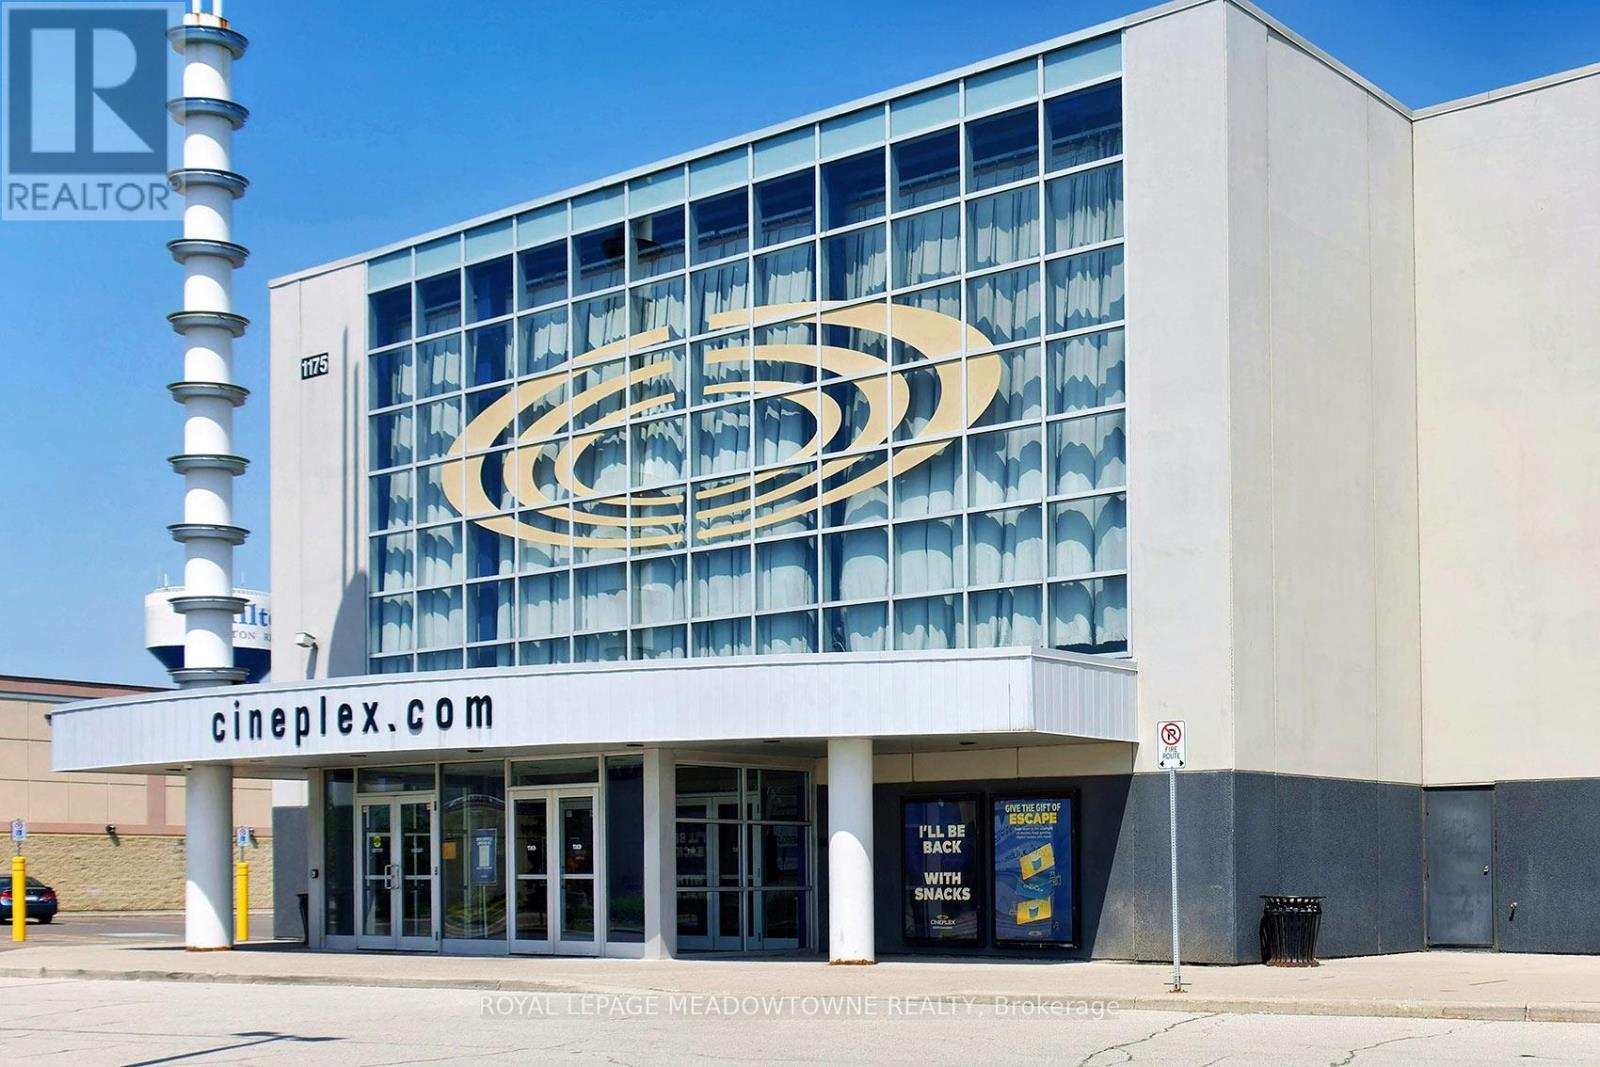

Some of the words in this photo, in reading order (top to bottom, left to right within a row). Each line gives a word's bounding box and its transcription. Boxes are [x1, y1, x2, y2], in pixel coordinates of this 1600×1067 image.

[301, 355, 328, 377] 1175
[211, 695, 494, 748] cineplex.com
[1164, 745, 1178, 753] FIRE
[1162, 752, 1181, 760] ROUTE
[1004, 804, 1021, 813] GIVE
[1022, 804, 1035, 813] THE
[1036, 803, 1050, 812] GIFT
[1051, 802, 1062, 812] OF
[1008, 812, 1058, 825] ESCAPE
[919, 825, 945, 838] I'LL
[947, 824, 966, 838] BE
[922, 840, 962, 854] BACK
[924, 872, 962, 885] WITH
[914, 887, 971, 901] SNACKS
